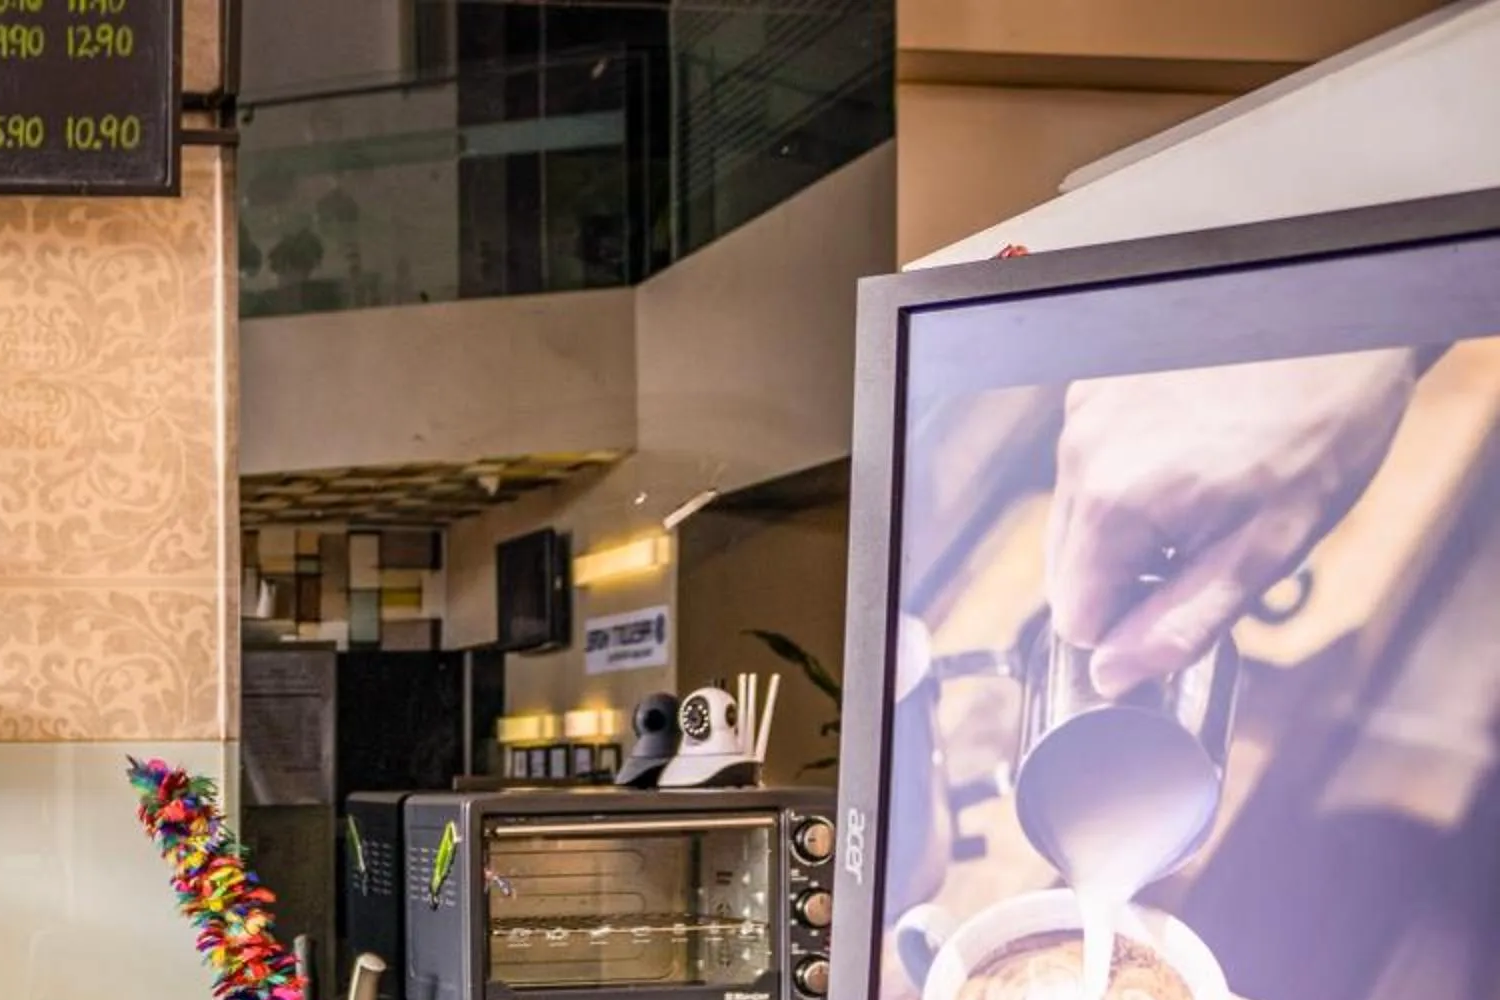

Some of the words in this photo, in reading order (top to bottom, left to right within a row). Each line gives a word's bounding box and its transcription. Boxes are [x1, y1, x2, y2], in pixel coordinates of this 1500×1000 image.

[67, 23, 134, 60] 12.90
[66, 113, 141, 150] 10.90
[845, 807, 865, 885] acer
